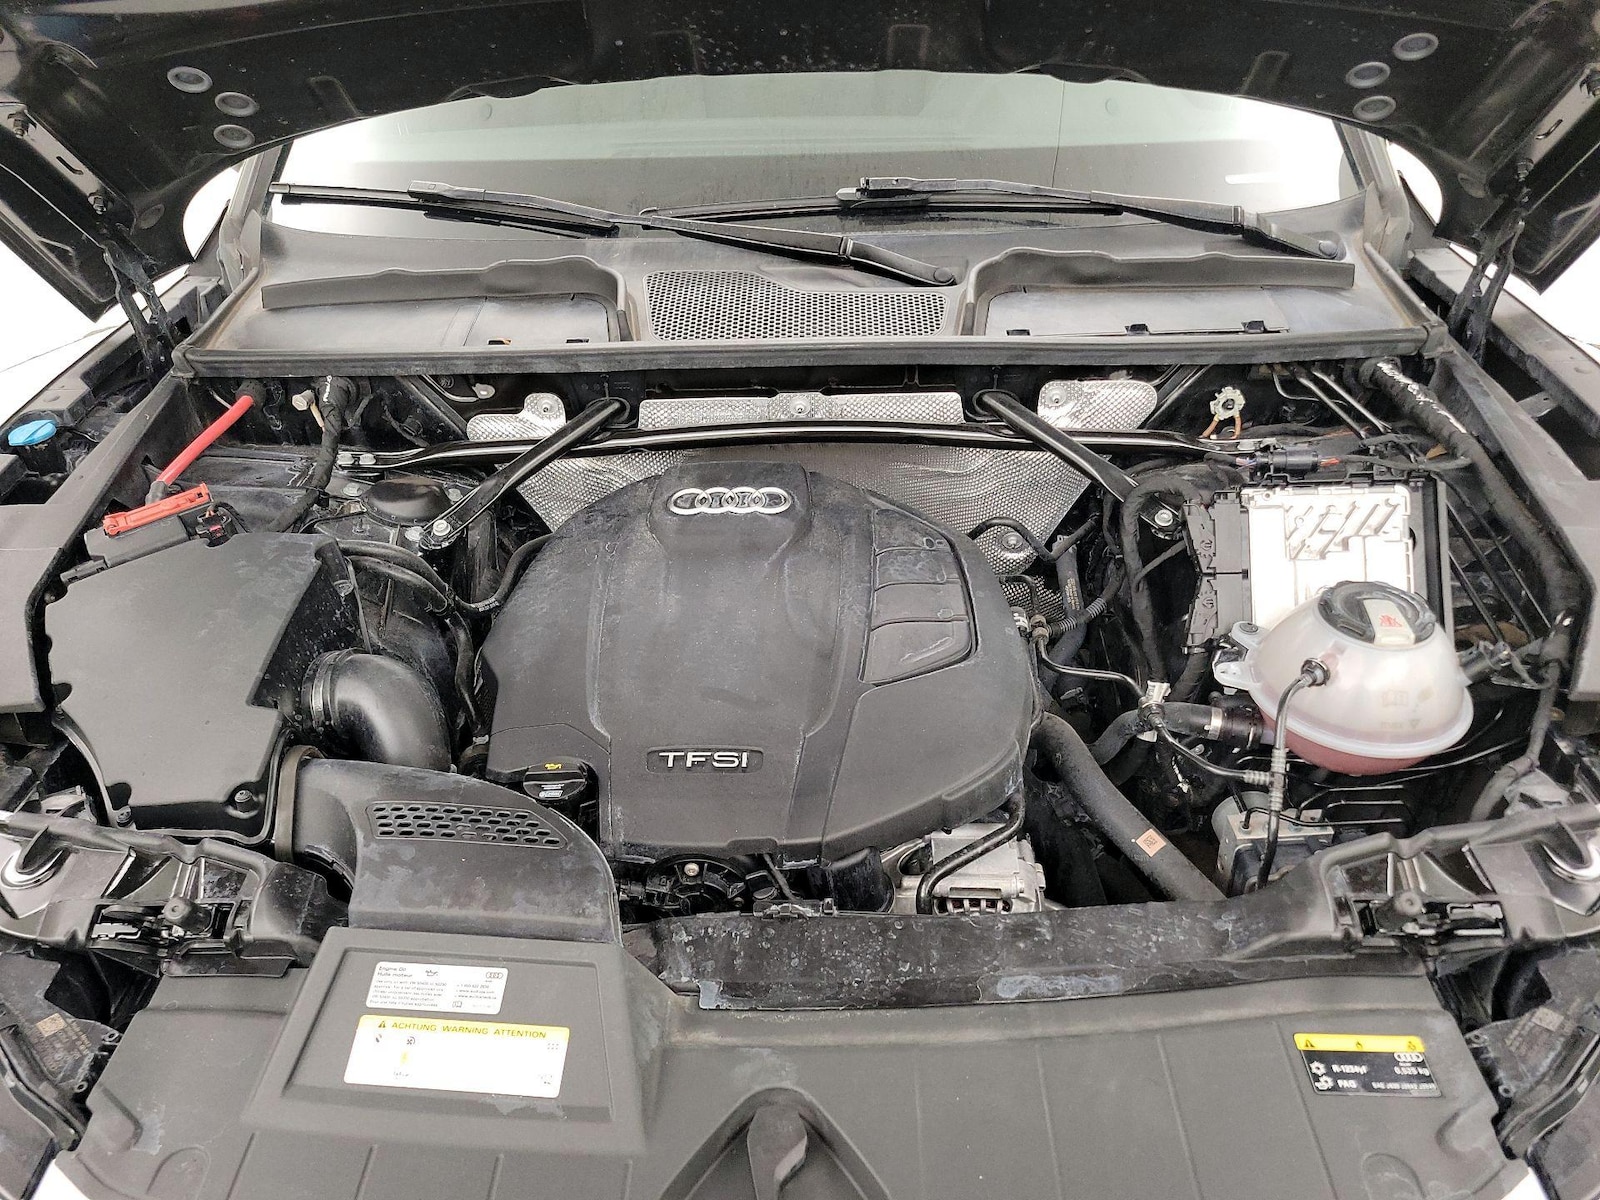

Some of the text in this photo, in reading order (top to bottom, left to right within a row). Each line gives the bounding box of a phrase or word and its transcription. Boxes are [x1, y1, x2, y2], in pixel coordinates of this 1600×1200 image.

[659, 752, 748, 768] TFSI
[391, 1022, 547, 1038] ACHTUNG WARNING ATTENTION
